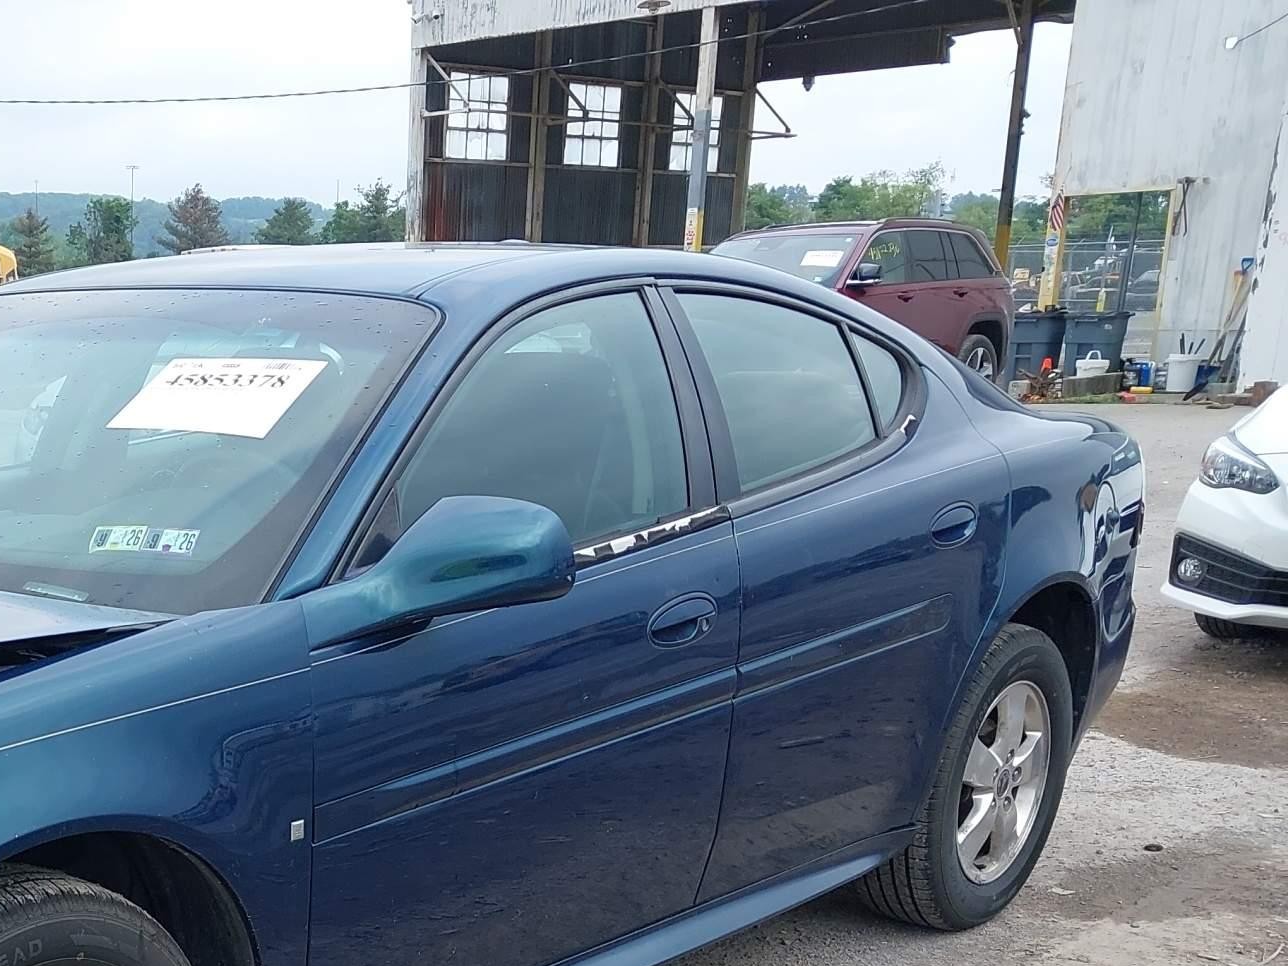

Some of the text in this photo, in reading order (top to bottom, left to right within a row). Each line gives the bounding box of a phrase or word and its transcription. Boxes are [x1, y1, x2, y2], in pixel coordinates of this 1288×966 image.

[165, 373, 291, 388] 45853378
[126, 529, 143, 546] 26
[178, 532, 197, 551] 26
